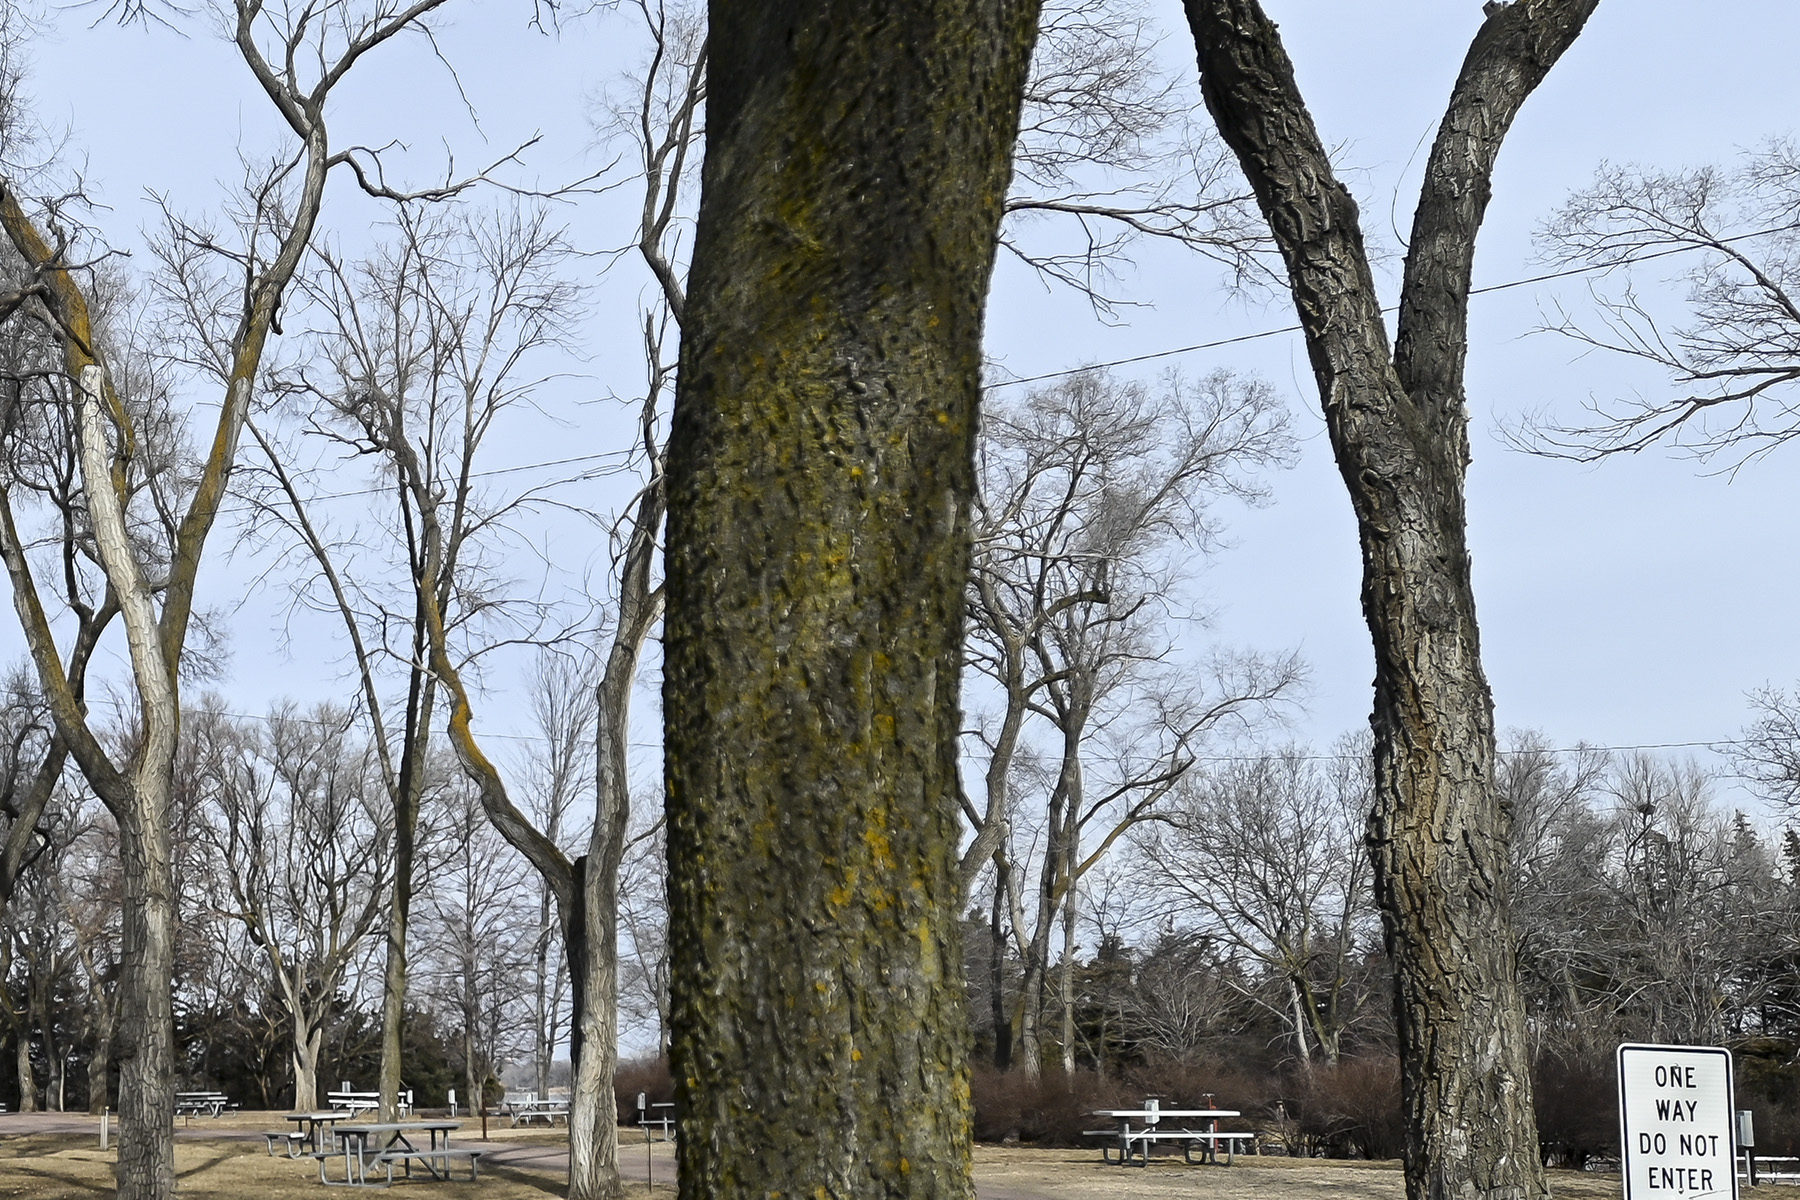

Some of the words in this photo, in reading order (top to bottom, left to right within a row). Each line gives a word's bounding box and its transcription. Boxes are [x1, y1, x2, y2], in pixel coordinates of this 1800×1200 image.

[1655, 1065, 1697, 1088] ONE
[1656, 1099, 1698, 1122] WAY
[1639, 1132, 1666, 1155] DO
[1680, 1134, 1718, 1157] NOT
[1648, 1167, 1713, 1191] ENTER
